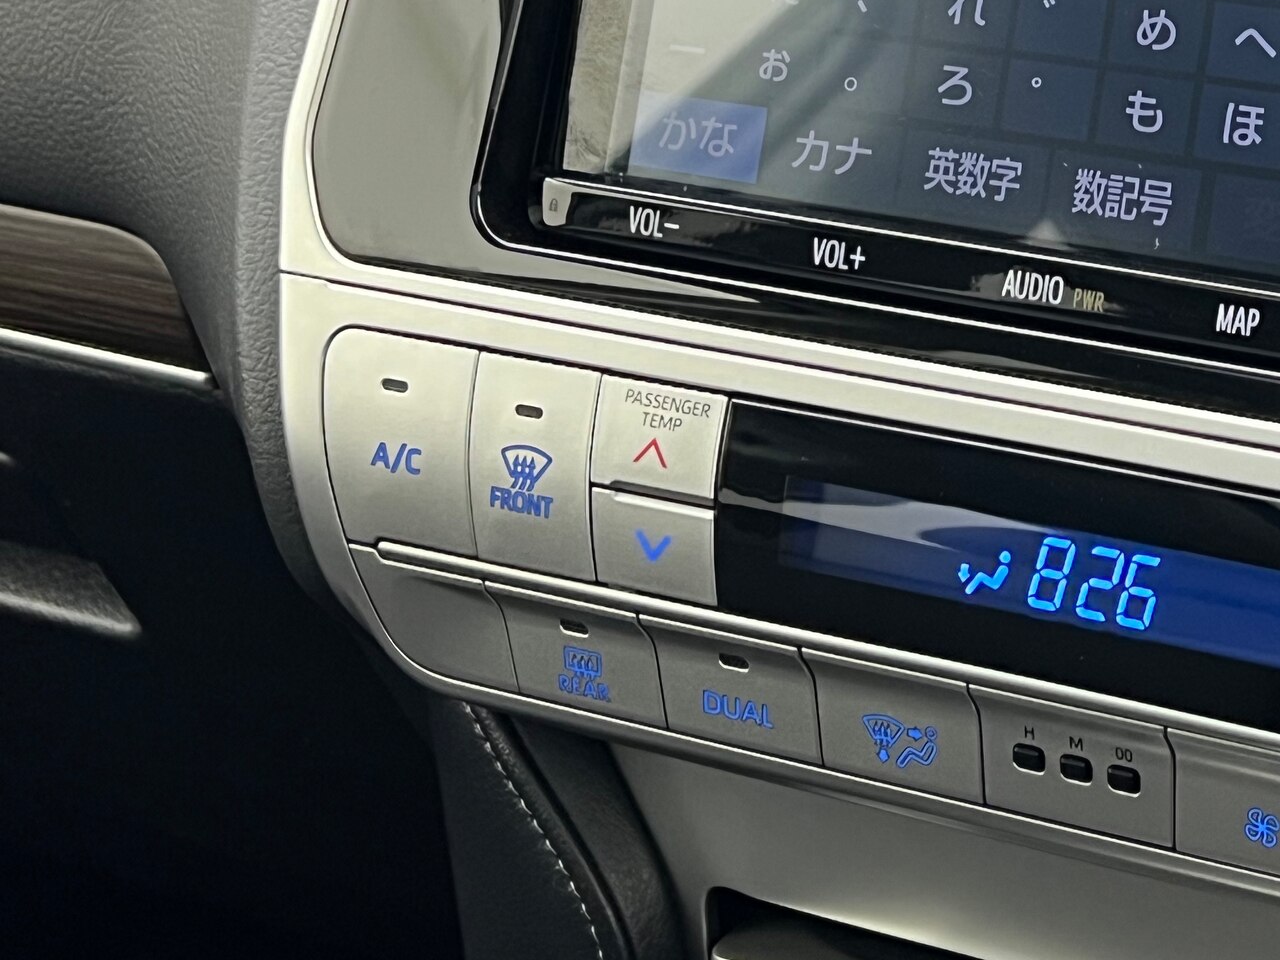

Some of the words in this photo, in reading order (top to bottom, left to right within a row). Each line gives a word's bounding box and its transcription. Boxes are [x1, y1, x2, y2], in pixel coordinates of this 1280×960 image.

[1136, 8, 1177, 51] め
[937, 64, 973, 107] ろ
[1125, 90, 1163, 133] も
[1223, 102, 1266, 146] ほ
[658, 110, 738, 158] かな
[791, 130, 873, 175] カナ
[924, 146, 1023, 202] 英数字
[1071, 168, 1173, 227] 数記号
[812, 237, 866, 270] VOL+
[1001, 270, 1065, 305] AUDIO
[1072, 288, 1106, 313] PWR
[1215, 303, 1261, 337] MAP
[625, 389, 711, 418] PASSENGER
[642, 412, 683, 432] TEMP
[370, 442, 422, 475] A/C
[490, 486, 553, 518] FRONT
[558, 674, 611, 702] REAR
[703, 689, 774, 729] DUAL
[1024, 726, 1035, 741] H
[1069, 737, 1084, 752] M
